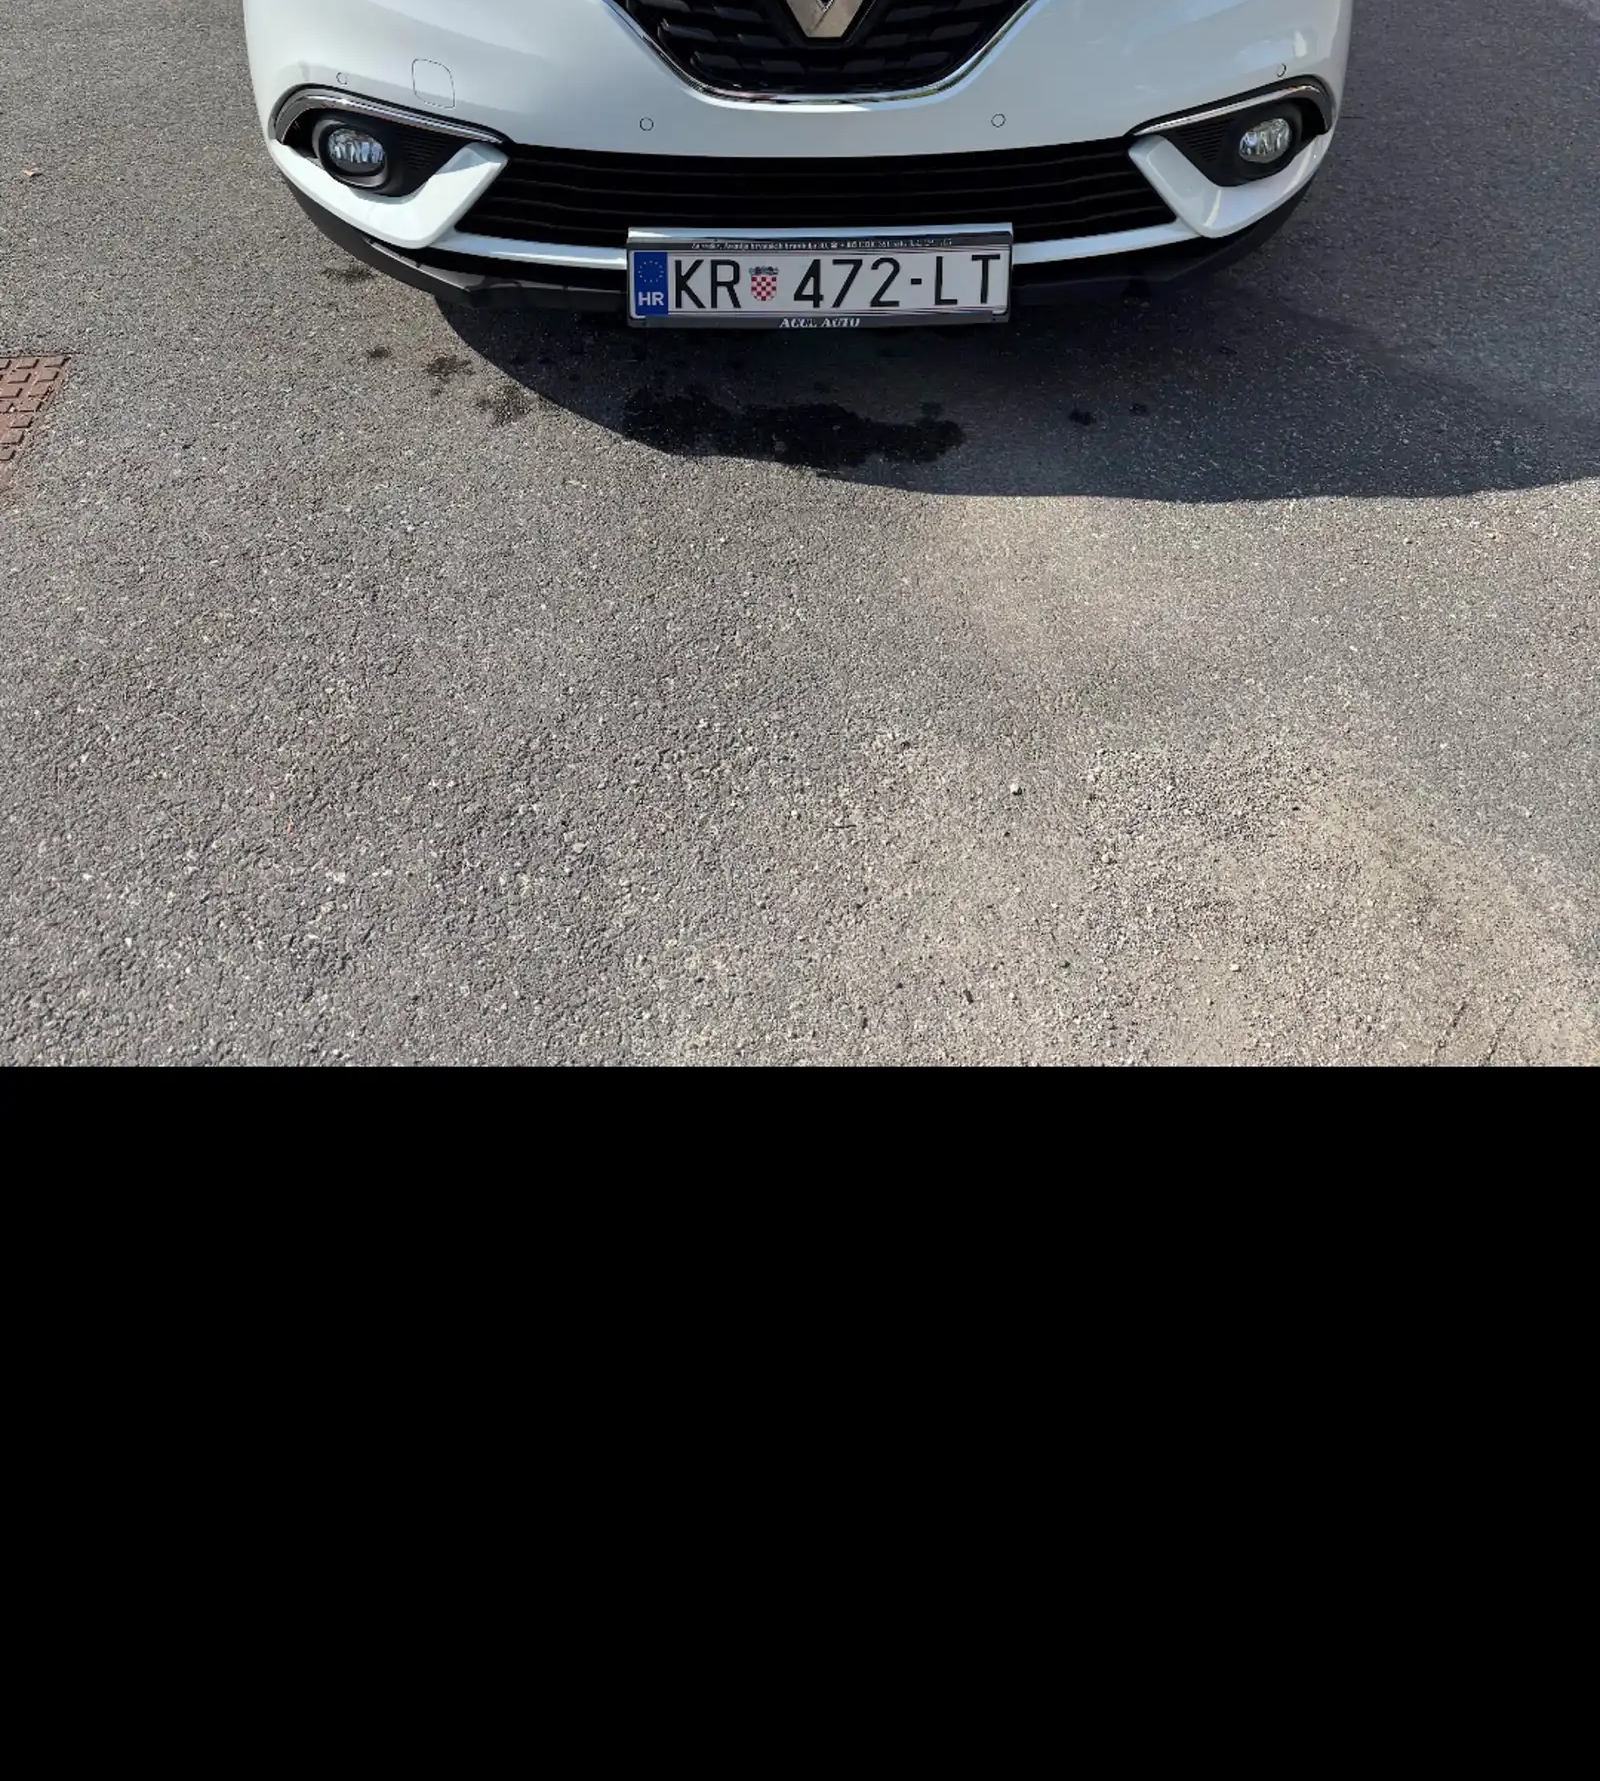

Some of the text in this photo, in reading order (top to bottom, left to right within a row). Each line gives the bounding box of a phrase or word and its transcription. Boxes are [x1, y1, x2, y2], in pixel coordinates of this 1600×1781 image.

[674, 254, 1001, 309] KR 472-LT
[638, 291, 664, 306] HR
[820, 317, 860, 328] AUTO
